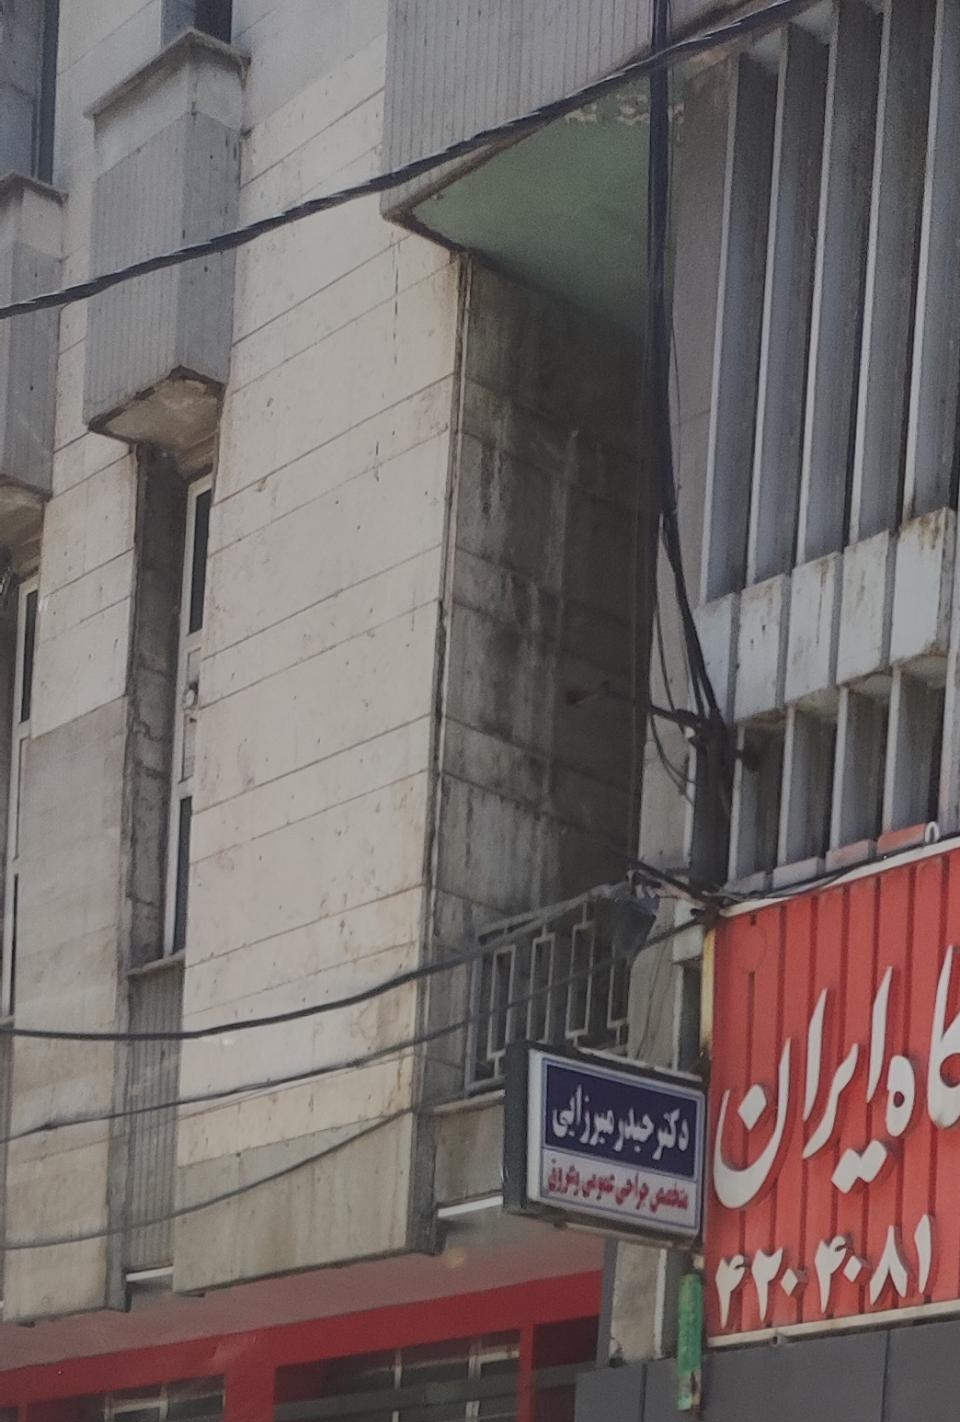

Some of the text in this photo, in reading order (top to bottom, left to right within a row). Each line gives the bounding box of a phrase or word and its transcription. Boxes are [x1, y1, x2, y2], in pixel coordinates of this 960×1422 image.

[552, 1084, 689, 1160] دکتر حیدر میرزایی
[713, 965, 891, 1209] ایران
[615, 1172, 649, 1209] جراحی
